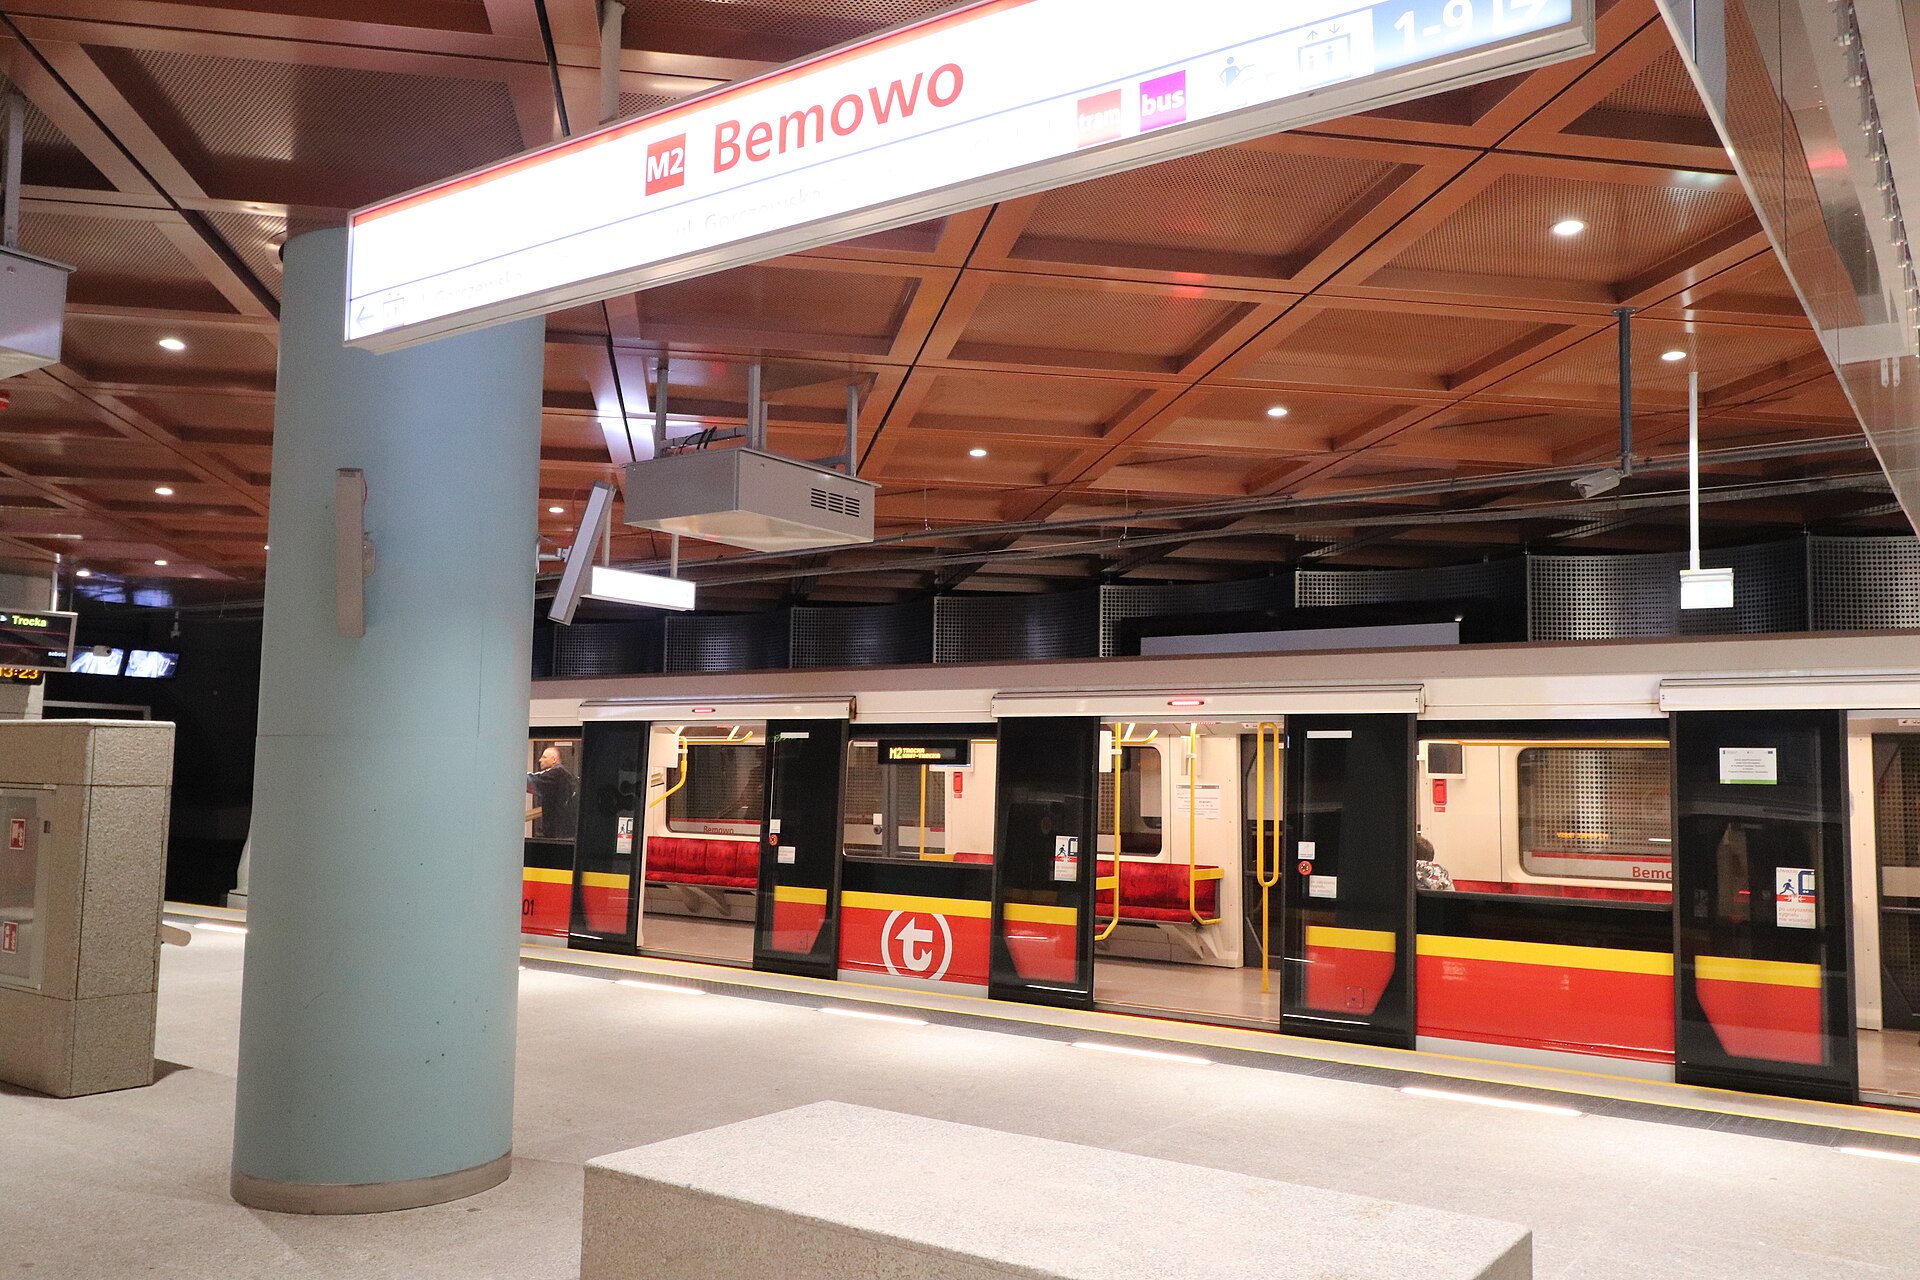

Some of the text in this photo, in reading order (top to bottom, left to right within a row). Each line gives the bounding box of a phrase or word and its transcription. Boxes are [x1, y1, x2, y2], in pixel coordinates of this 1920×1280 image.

[1078, 89, 1185, 133] tram bus
[646, 63, 964, 183] M2 Bemowo
[12, 615, 47, 627] Trocka
[889, 747, 903, 760] M2
[704, 825, 735, 835] Bemowo
[523, 898, 535, 916] 01
